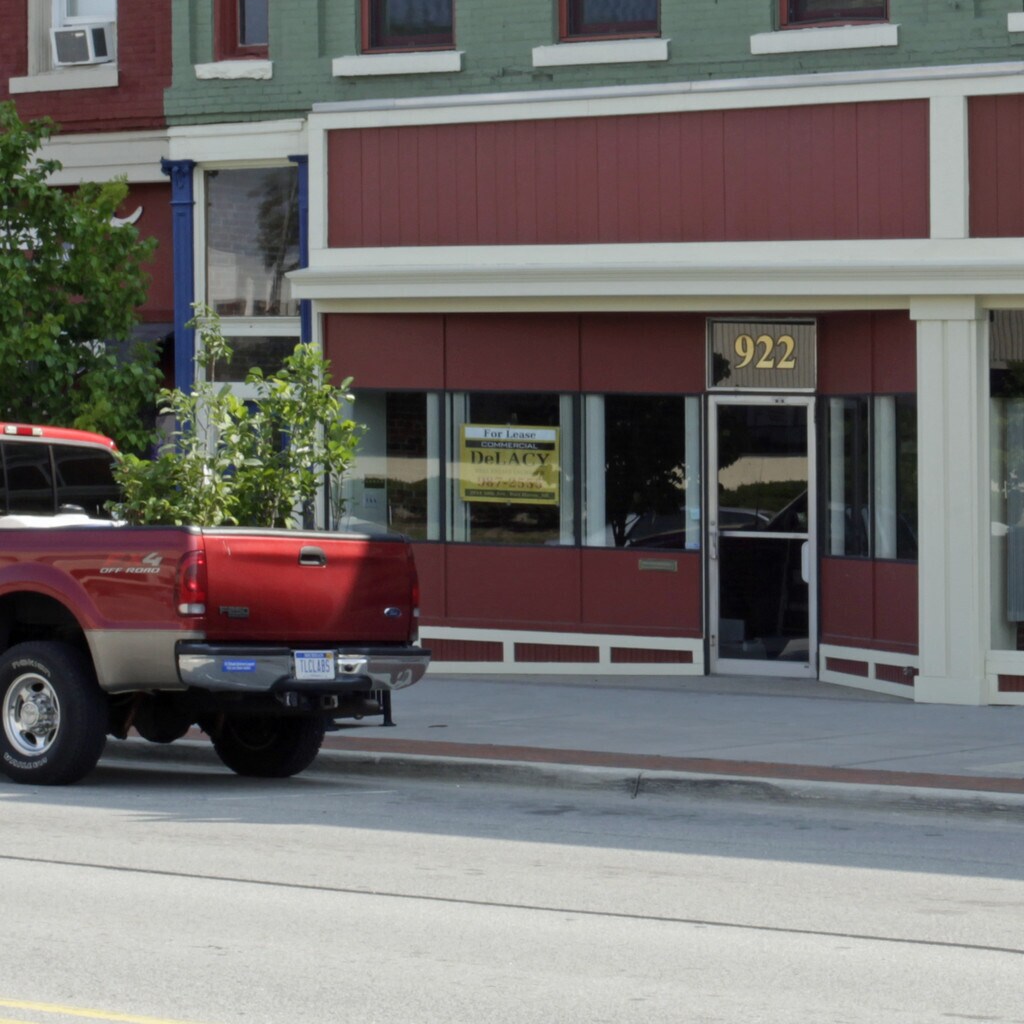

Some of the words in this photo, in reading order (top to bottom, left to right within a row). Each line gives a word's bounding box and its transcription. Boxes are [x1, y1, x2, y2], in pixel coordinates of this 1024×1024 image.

[734, 334, 797, 369] 922
[483, 428, 502, 439] For
[506, 429, 537, 440] Lease
[481, 441, 538, 450] COMMERCIAL
[470, 450, 551, 466] DeLACY
